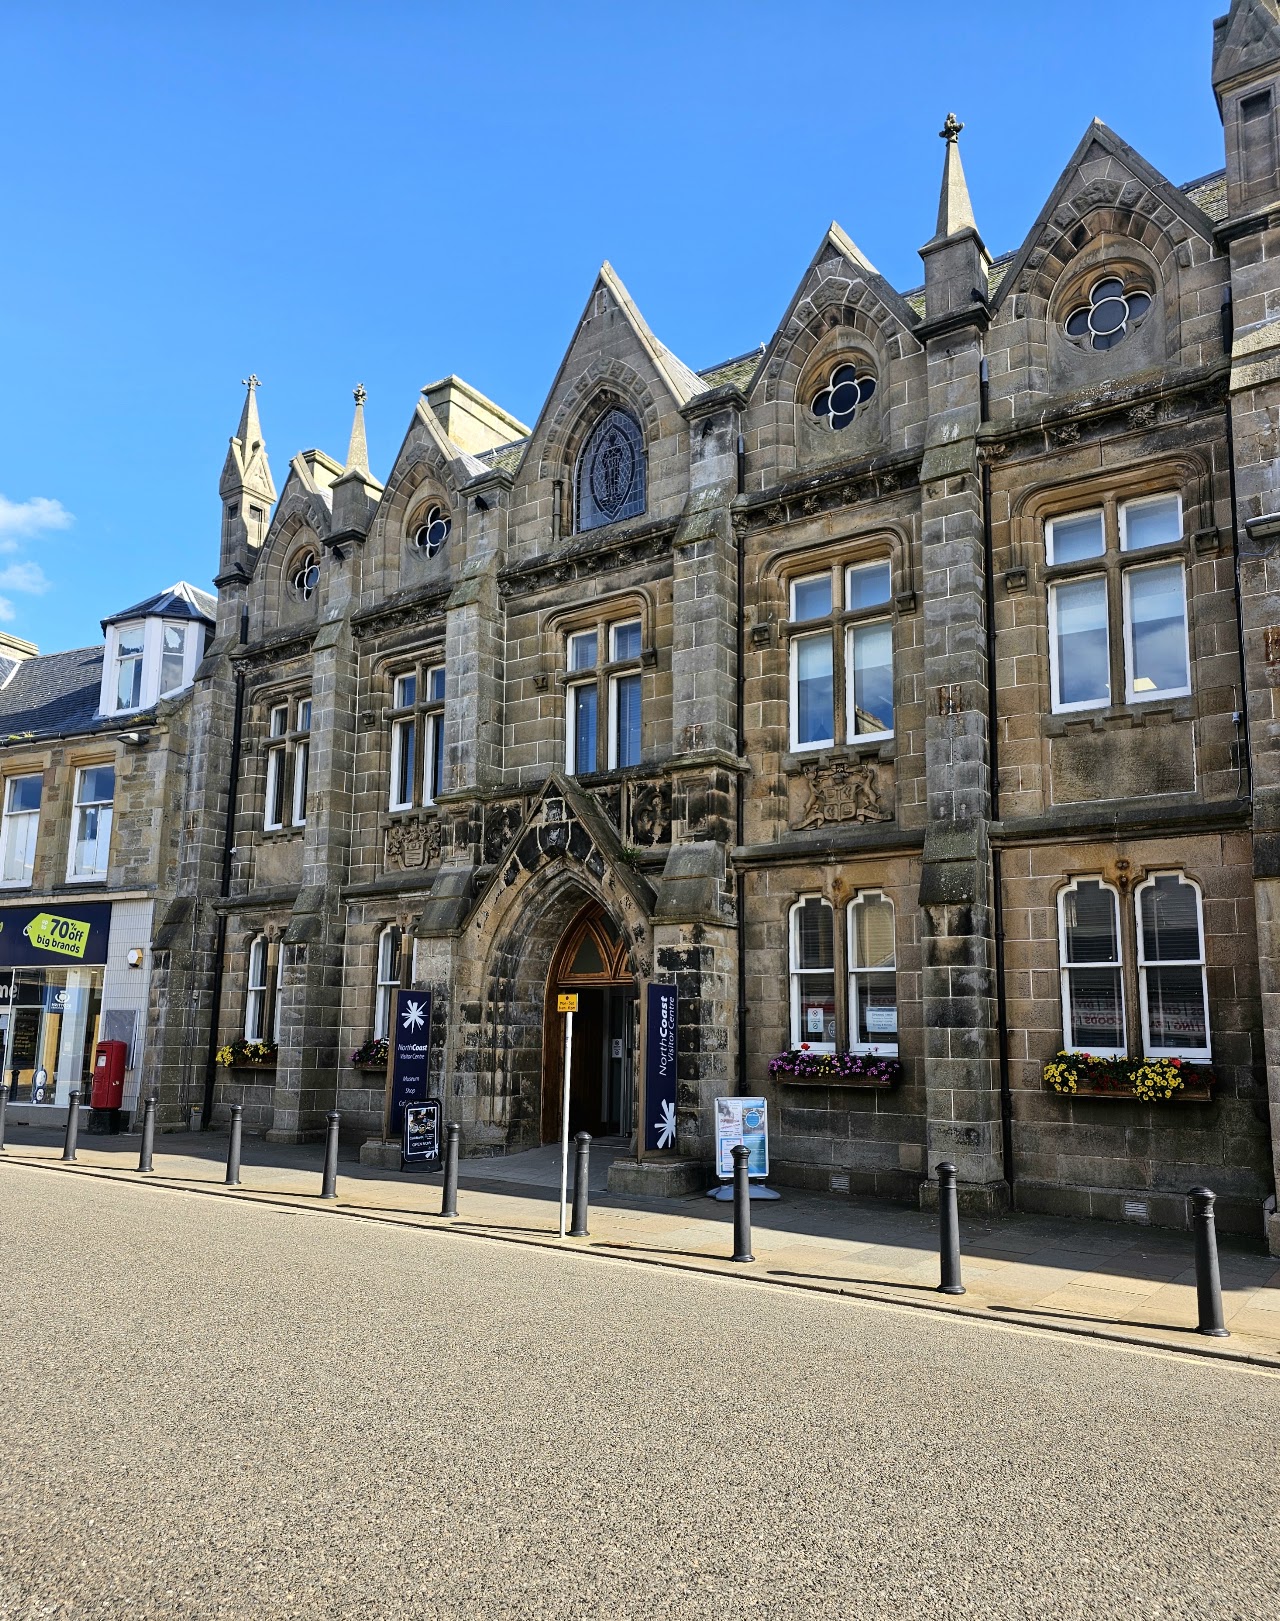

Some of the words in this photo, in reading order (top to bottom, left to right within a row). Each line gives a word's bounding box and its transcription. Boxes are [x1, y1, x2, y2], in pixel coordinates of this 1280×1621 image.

[68, 930, 84, 942] off
[36, 934, 50, 947] big
[51, 938, 80, 953] brands
[659, 995, 668, 1076] NorthCoast
[397, 1043, 428, 1051] NorthCoast
[404, 1087, 416, 1095] Shop
